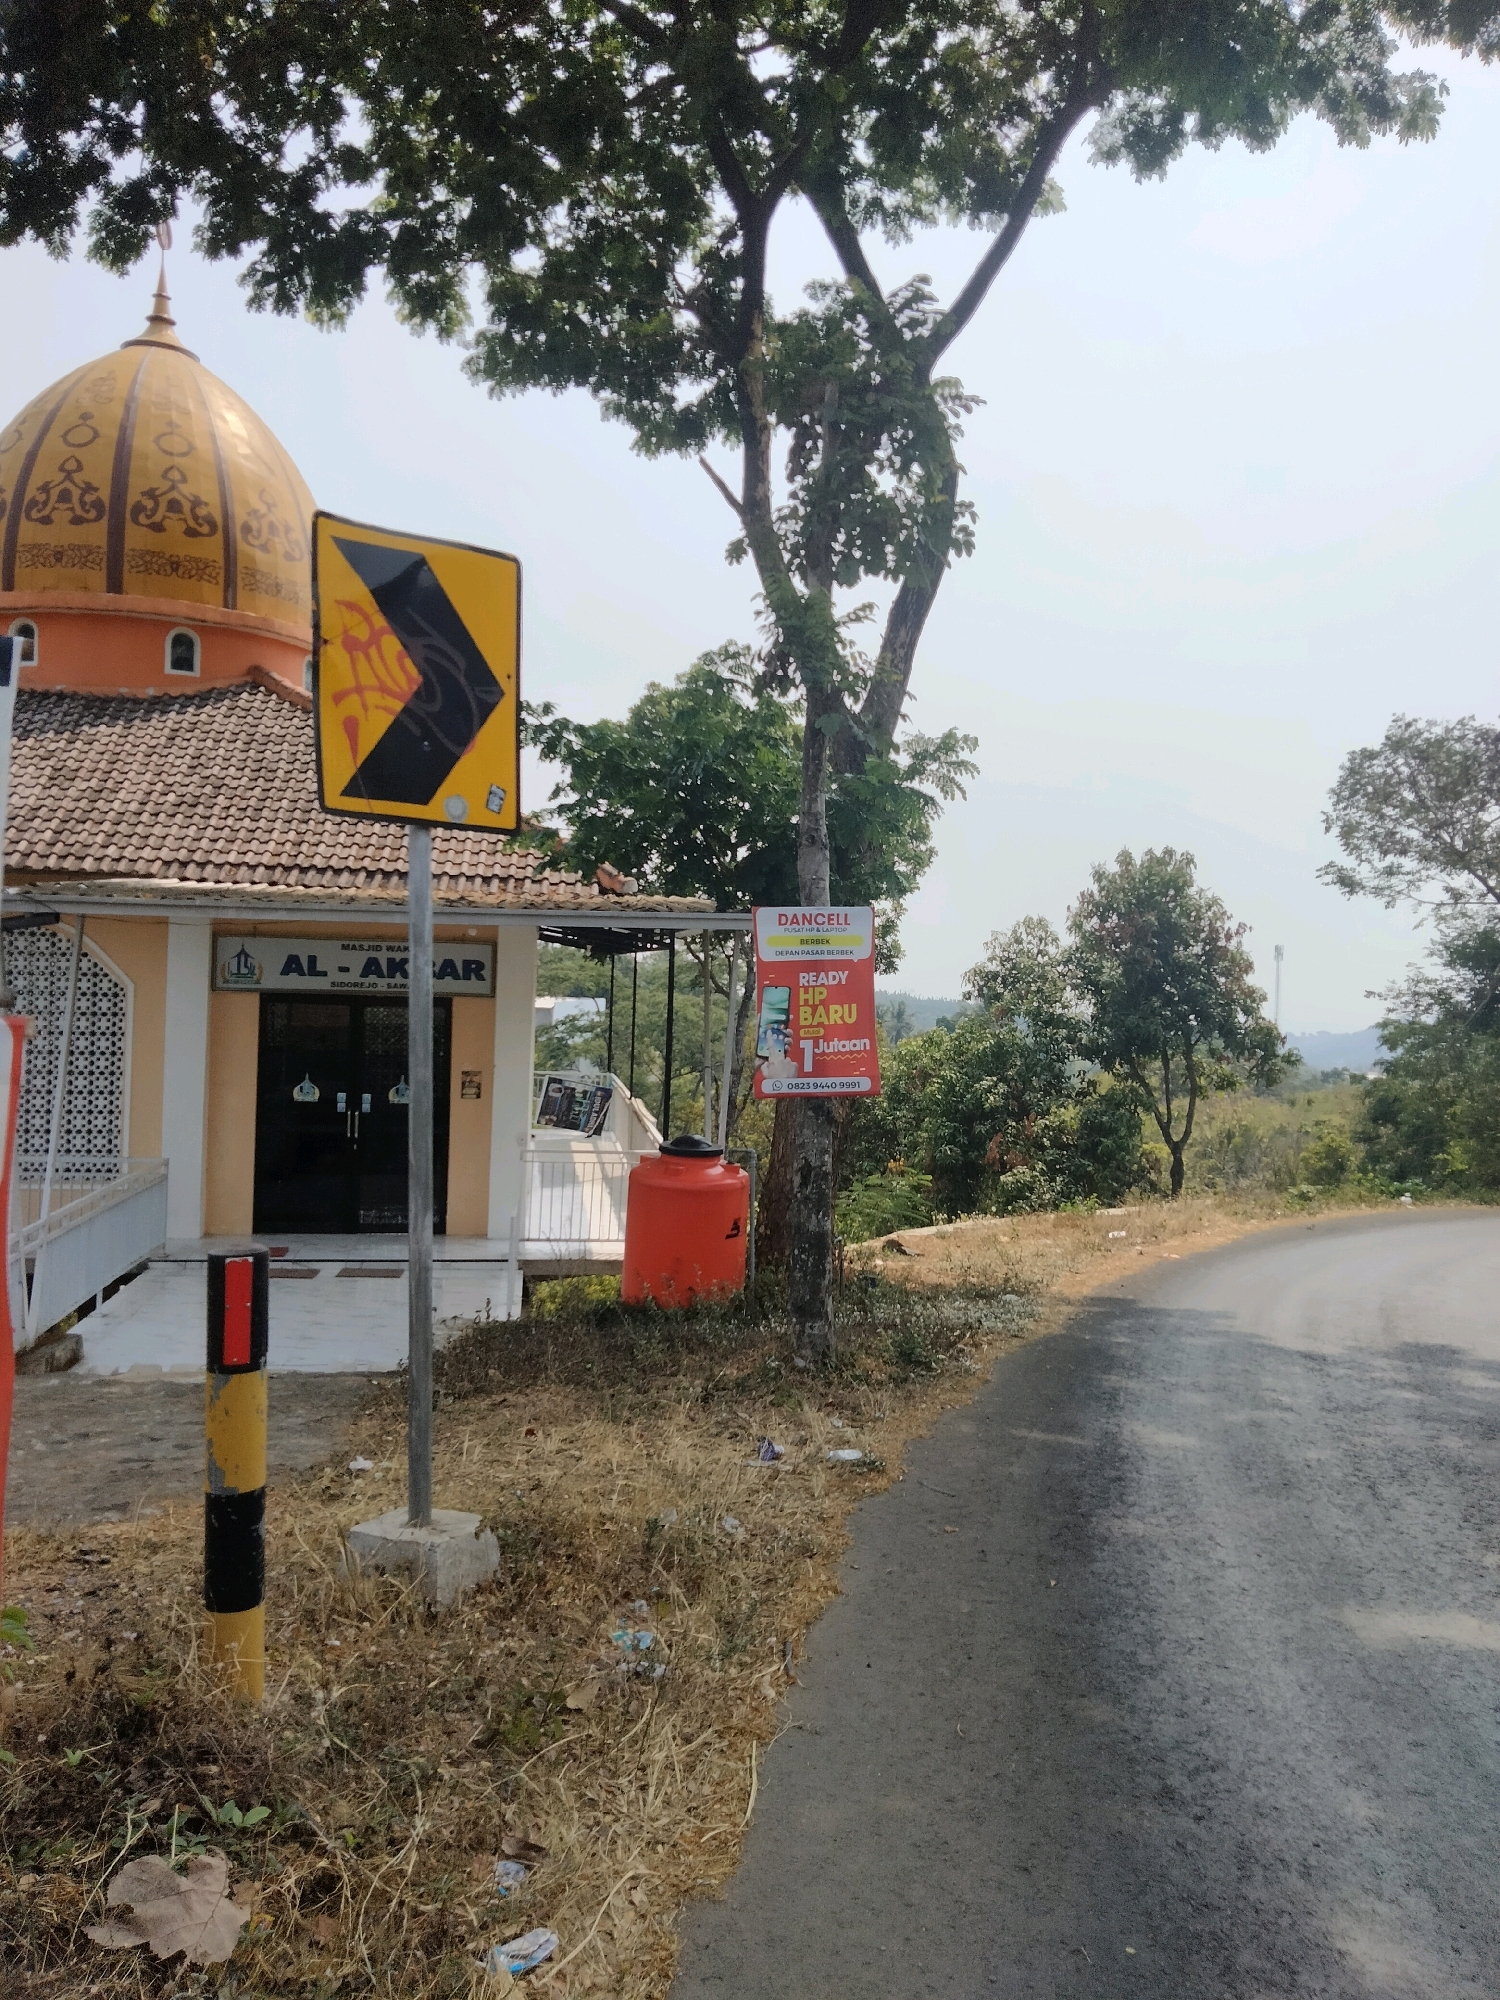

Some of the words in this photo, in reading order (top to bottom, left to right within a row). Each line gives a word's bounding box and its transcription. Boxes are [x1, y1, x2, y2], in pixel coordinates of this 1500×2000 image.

[778, 913, 850, 926] DANCELL
[341, 943, 383, 953] MASJID
[279, 953, 328, 977] AL
[359, 956, 486, 981] AKAR
[331, 981, 378, 989] SIDOREJO
[799, 970, 849, 986] READY
[800, 987, 828, 1005] HP
[799, 1003, 857, 1025] BARU
[800, 1039, 813, 1072] 1
[814, 1038, 870, 1053] Jutaan
[787, 1082, 811, 1090] 0823
[839, 1081, 861, 1089] 9991
